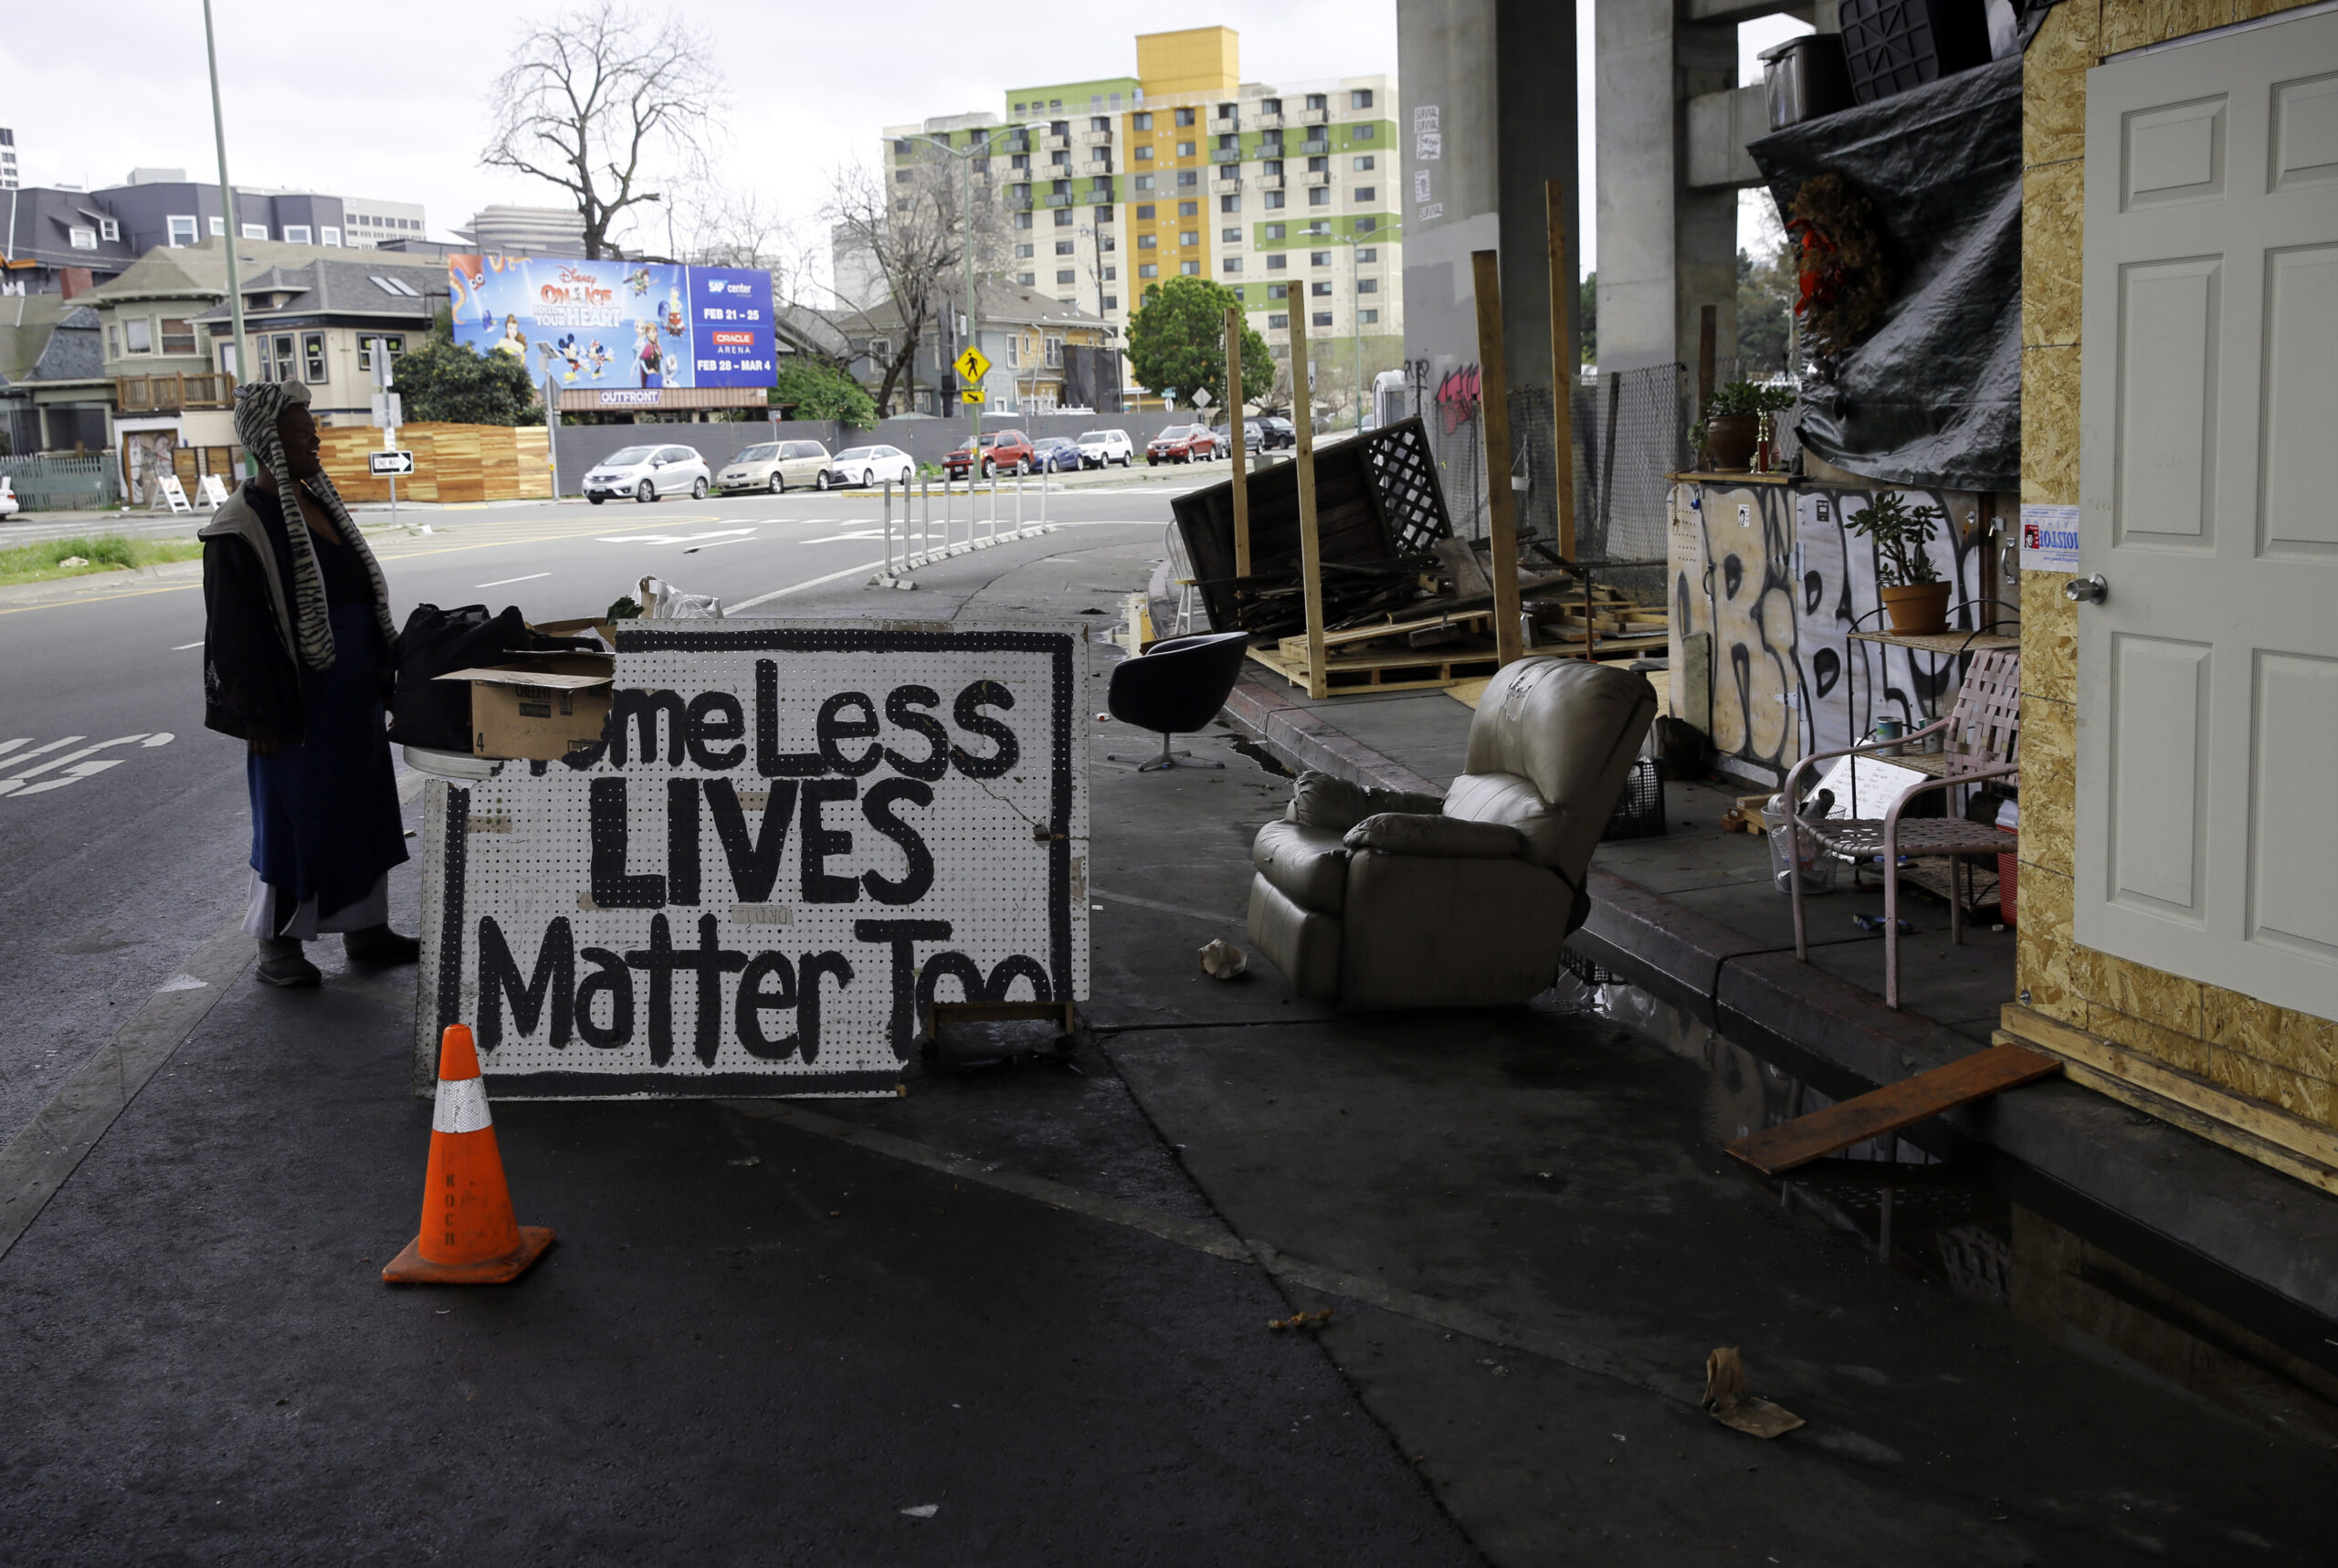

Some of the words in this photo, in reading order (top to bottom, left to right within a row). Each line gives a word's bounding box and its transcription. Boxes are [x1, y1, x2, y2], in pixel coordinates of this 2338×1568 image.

[708, 279, 728, 293] SAP
[727, 283, 752, 294] center
[541, 284, 570, 304] ON
[585, 286, 615, 306] ICE
[536, 314, 566, 327] YOUR
[565, 306, 622, 328] HEART
[703, 308, 724, 320] FEB
[725, 309, 737, 321] 21
[746, 310, 760, 321] 25
[716, 334, 751, 342] ORACLE
[717, 346, 751, 354] ARENA
[697, 360, 718, 371] FEB
[719, 360, 732, 371] 28
[741, 360, 764, 371] MAR
[764, 361, 771, 371] 4
[601, 391, 658, 403] OUTFRONT
[376, 458, 388, 469] ONE
[476, 731, 485, 752] 4
[589, 776, 935, 910] LIVES
[477, 913, 855, 1068] Matter
